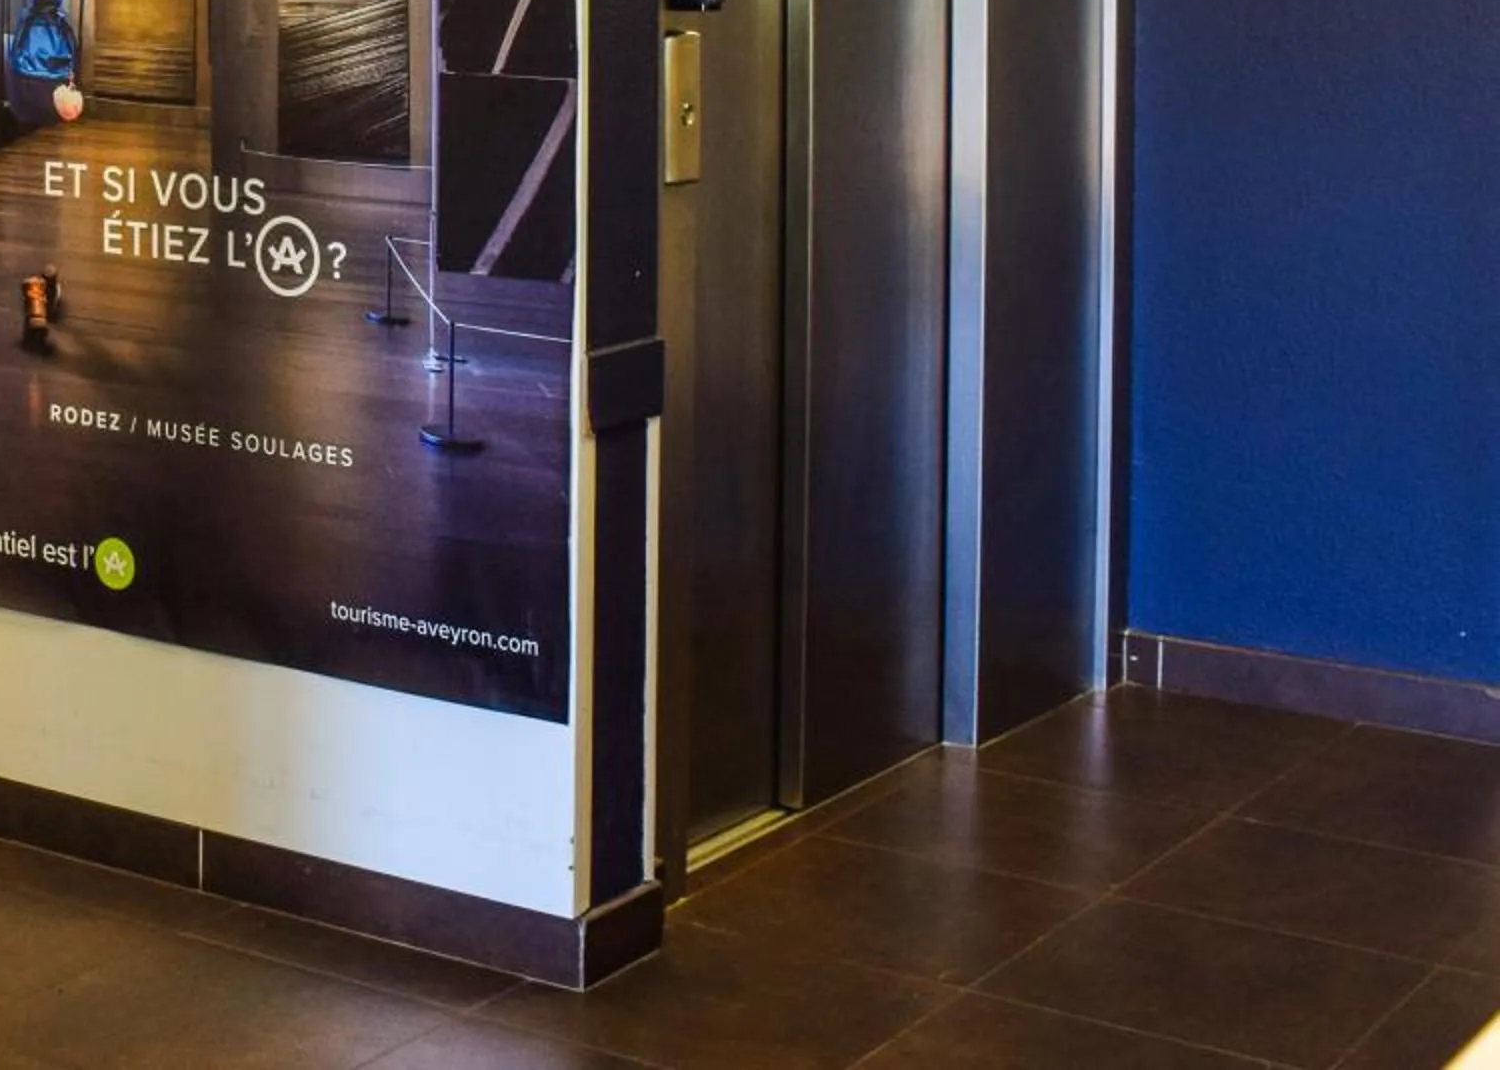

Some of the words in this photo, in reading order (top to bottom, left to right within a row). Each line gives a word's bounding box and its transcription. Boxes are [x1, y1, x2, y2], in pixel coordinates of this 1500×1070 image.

[44, 161, 88, 199] ET
[102, 165, 135, 204] SI
[151, 170, 266, 215] VOUS
[103, 210, 210, 264] ÉTIEZ
[49, 403, 121, 431] RODEZ
[147, 419, 221, 447] MUSÉE
[231, 431, 354, 467] SOULAGES
[42, 543, 78, 569] est
[330, 600, 540, 657] tourisme-aveyron.com
